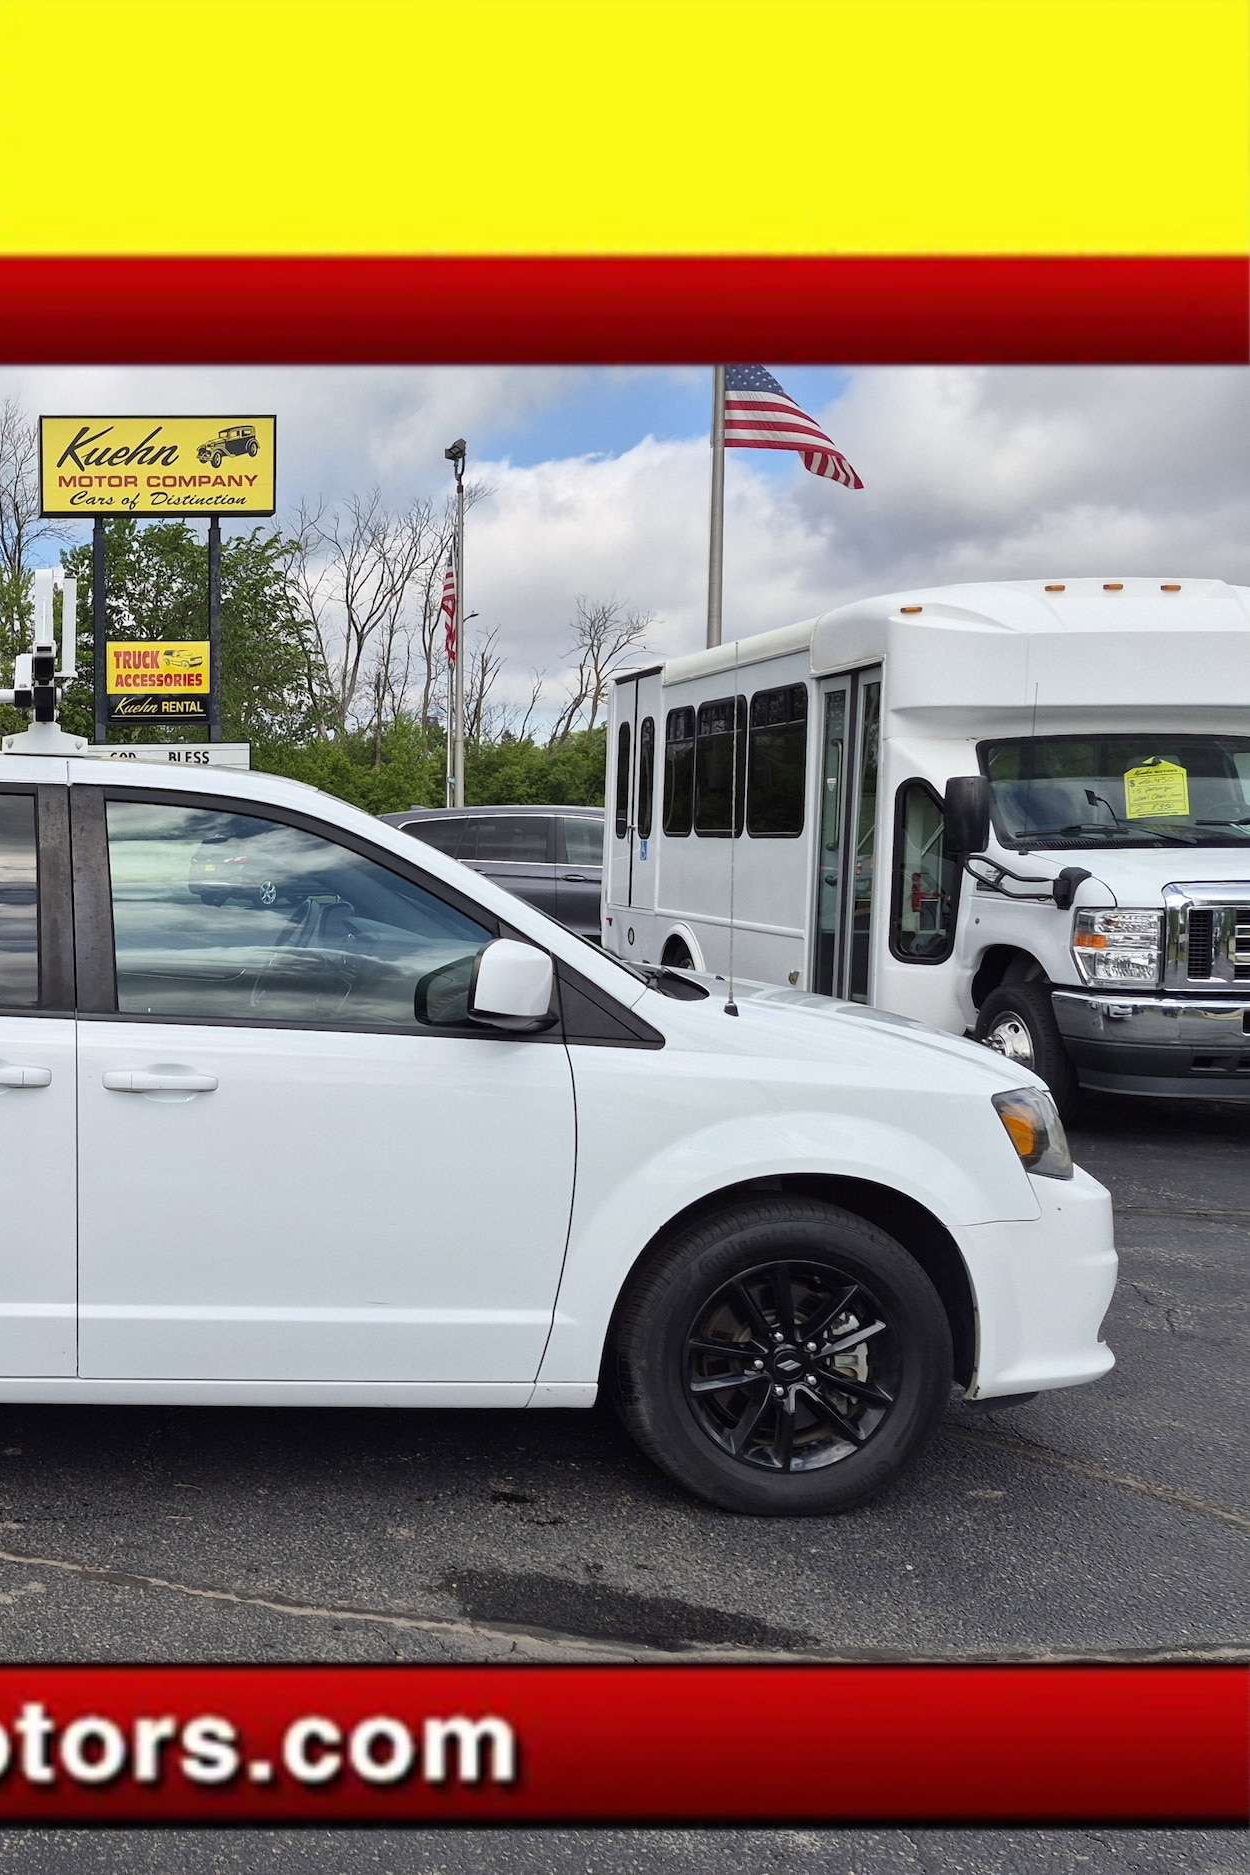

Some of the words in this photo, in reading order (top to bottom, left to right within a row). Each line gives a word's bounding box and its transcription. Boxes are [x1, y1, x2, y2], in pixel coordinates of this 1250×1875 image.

[56, 426, 179, 472] Kuehn
[58, 475, 138, 488] MOTOR
[146, 474, 259, 488] COMPANY
[69, 490, 114, 506] Cars
[121, 493, 140, 510] of
[149, 491, 247, 506] Distinction
[113, 650, 160, 670] TRUCK
[114, 673, 203, 688] ACCESSORIES
[113, 696, 159, 716] Kuehn
[161, 700, 204, 713] RENTAL
